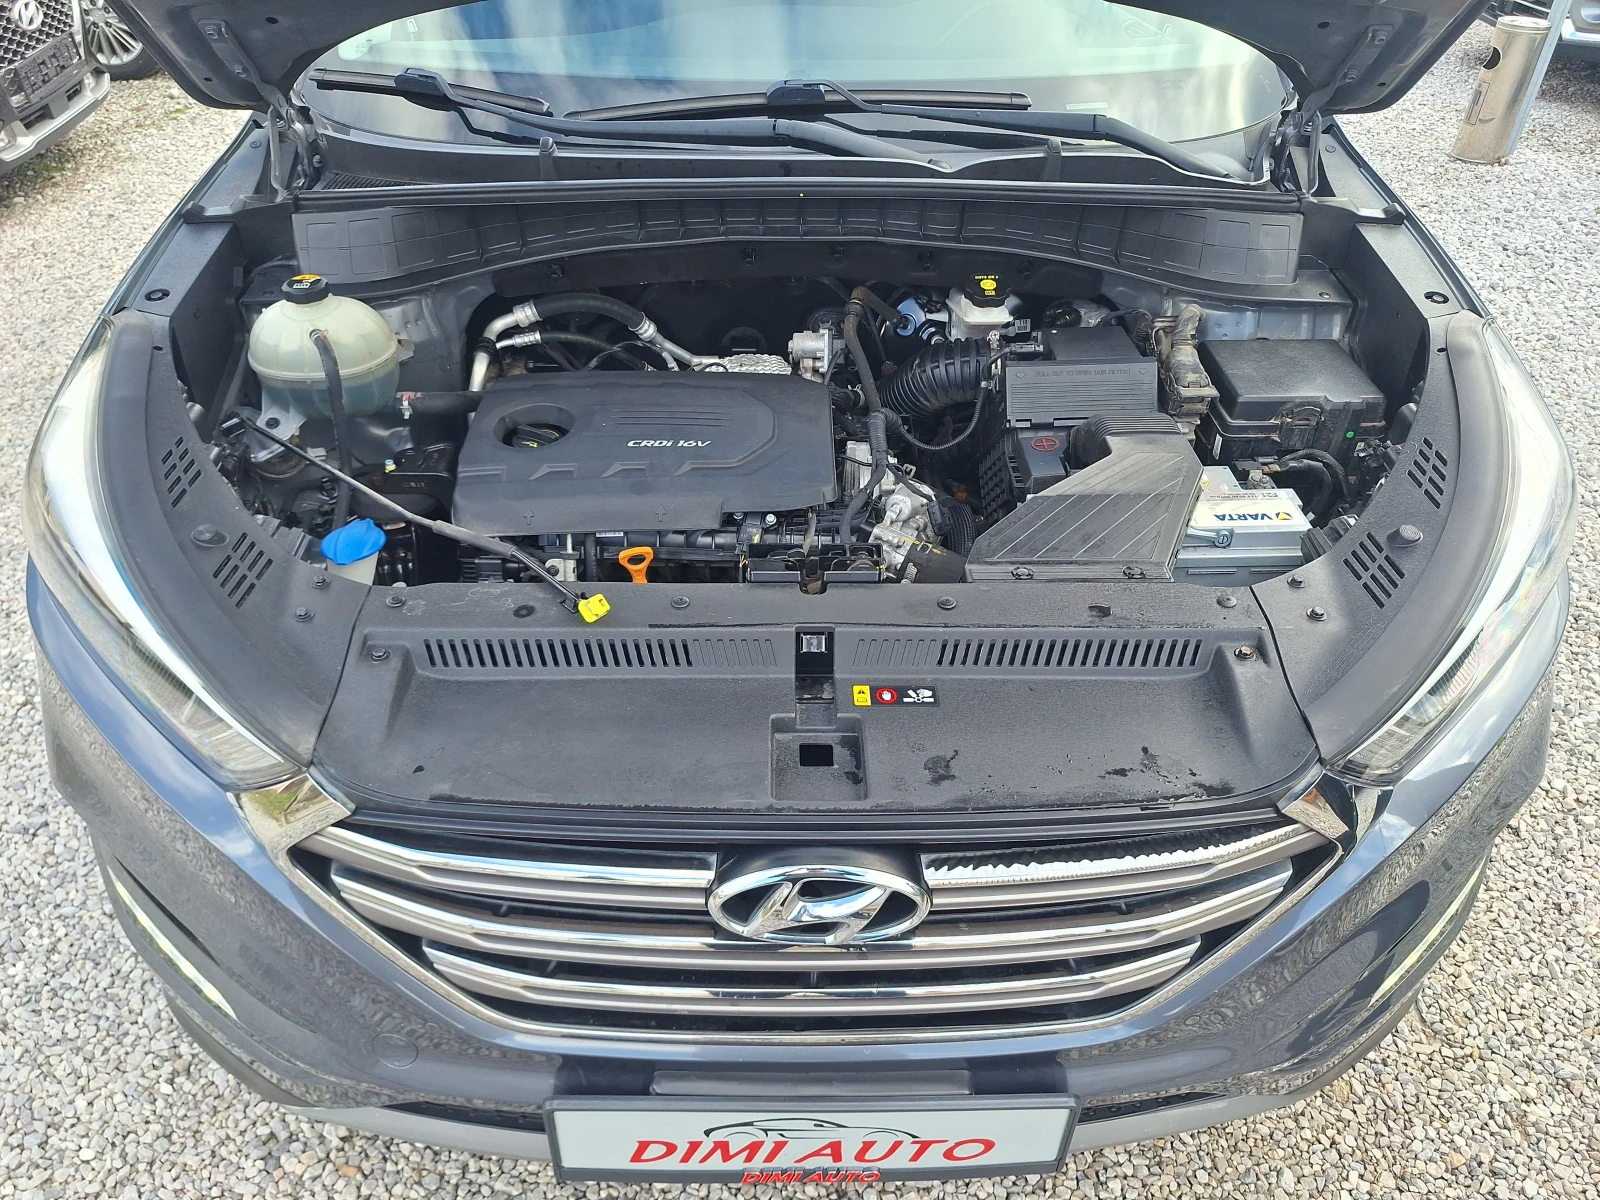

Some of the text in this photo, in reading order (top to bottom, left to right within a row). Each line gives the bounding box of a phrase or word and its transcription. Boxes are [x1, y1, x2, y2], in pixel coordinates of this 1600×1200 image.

[1214, 513, 1273, 521] VARTA
[628, 1138, 997, 1164] DIMI AUTO
